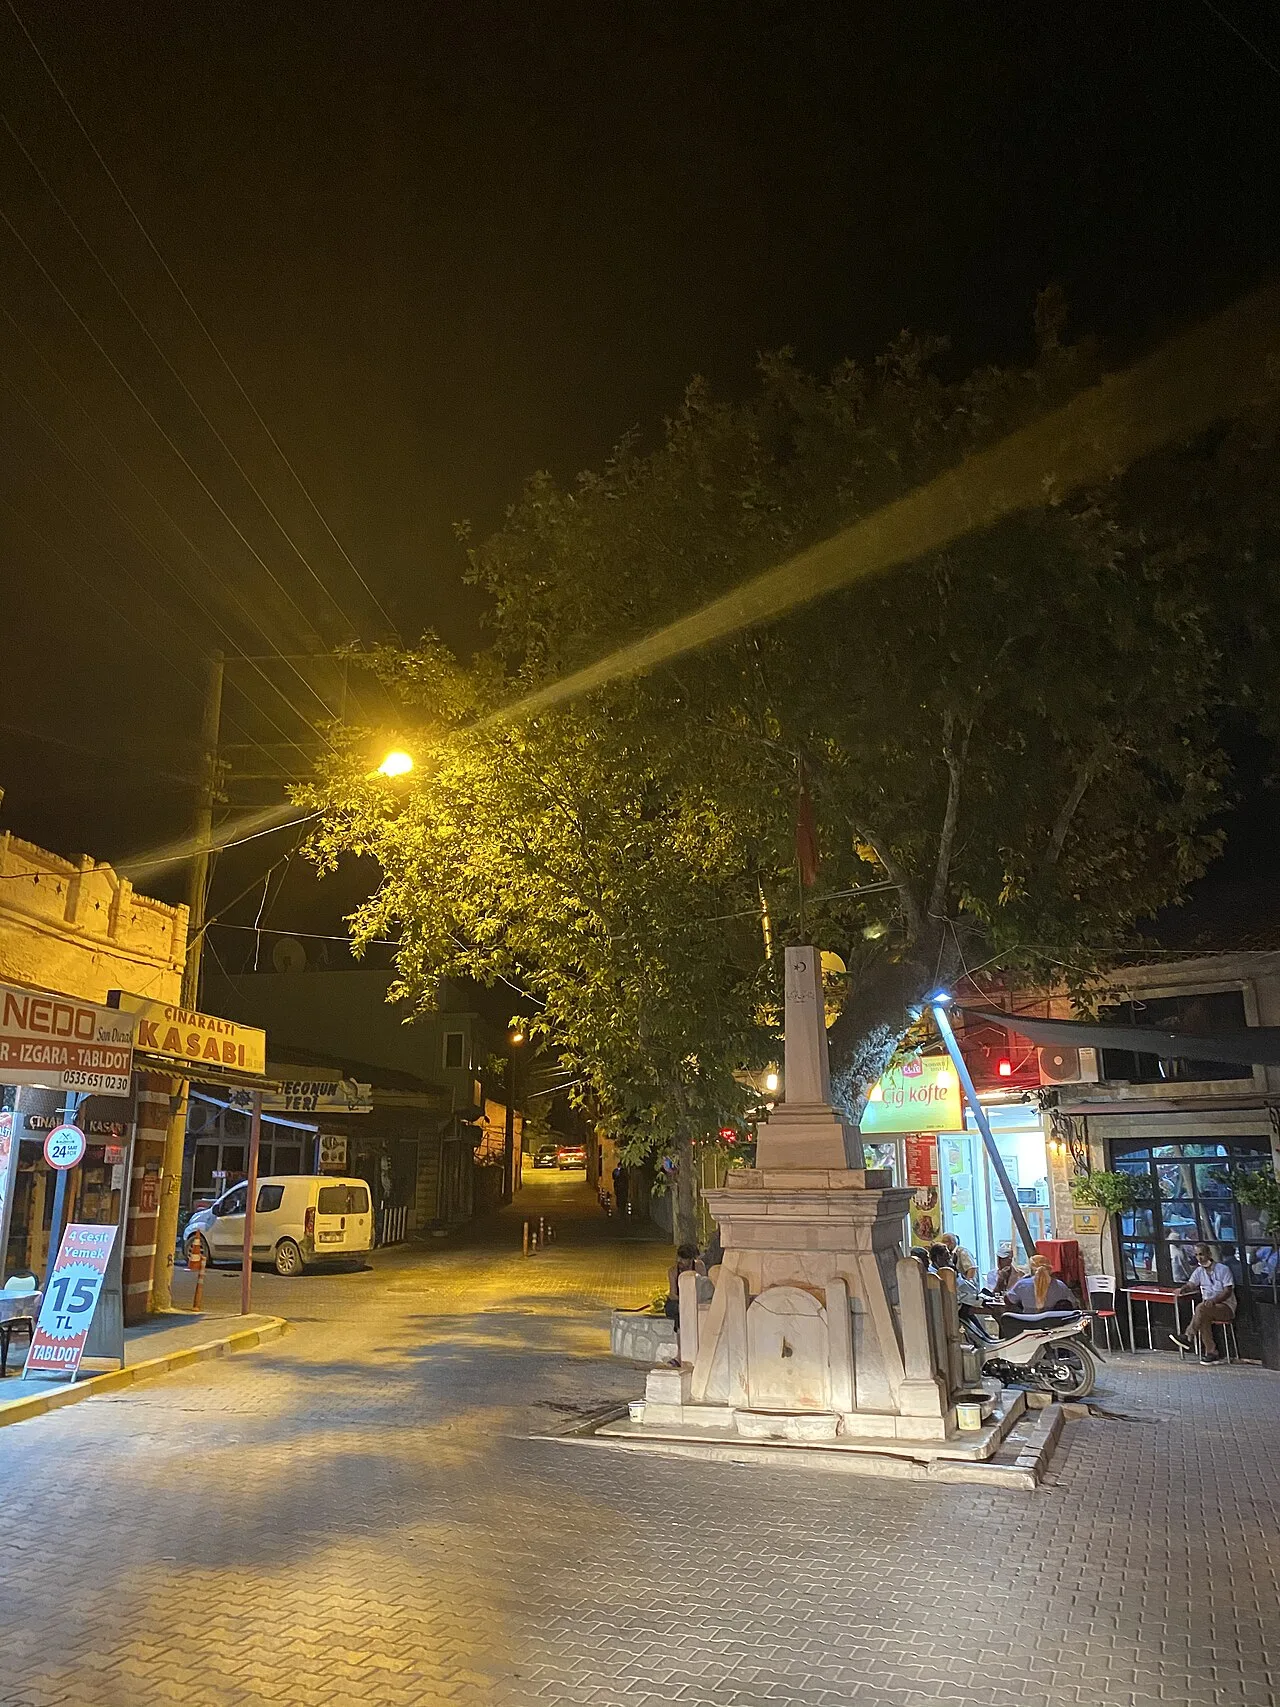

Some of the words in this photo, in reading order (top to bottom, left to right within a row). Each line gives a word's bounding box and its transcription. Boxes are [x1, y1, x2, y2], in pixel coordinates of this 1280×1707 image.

[3, 992, 96, 1041] NEDO
[164, 1007, 234, 1036] ÇINARALTI
[138, 1019, 245, 1067] KASABI
[20, 1044, 68, 1065] IZGARA
[77, 1048, 129, 1069] TABLDOT
[63, 1071, 87, 1085] 0535
[87, 1073, 104, 1088] 651
[105, 1076, 116, 1090] 02
[117, 1079, 128, 1091] 30
[882, 1087, 904, 1108] Çiğ
[909, 1083, 948, 1105] köfte
[52, 1145, 67, 1158] 24
[69, 1231, 75, 1241] 4
[79, 1231, 109, 1244] Çeşit
[64, 1246, 105, 1259] Yemek
[52, 1277, 98, 1314] 15
[56, 1315, 73, 1330] TL
[32, 1345, 80, 1363] TABLDOT
